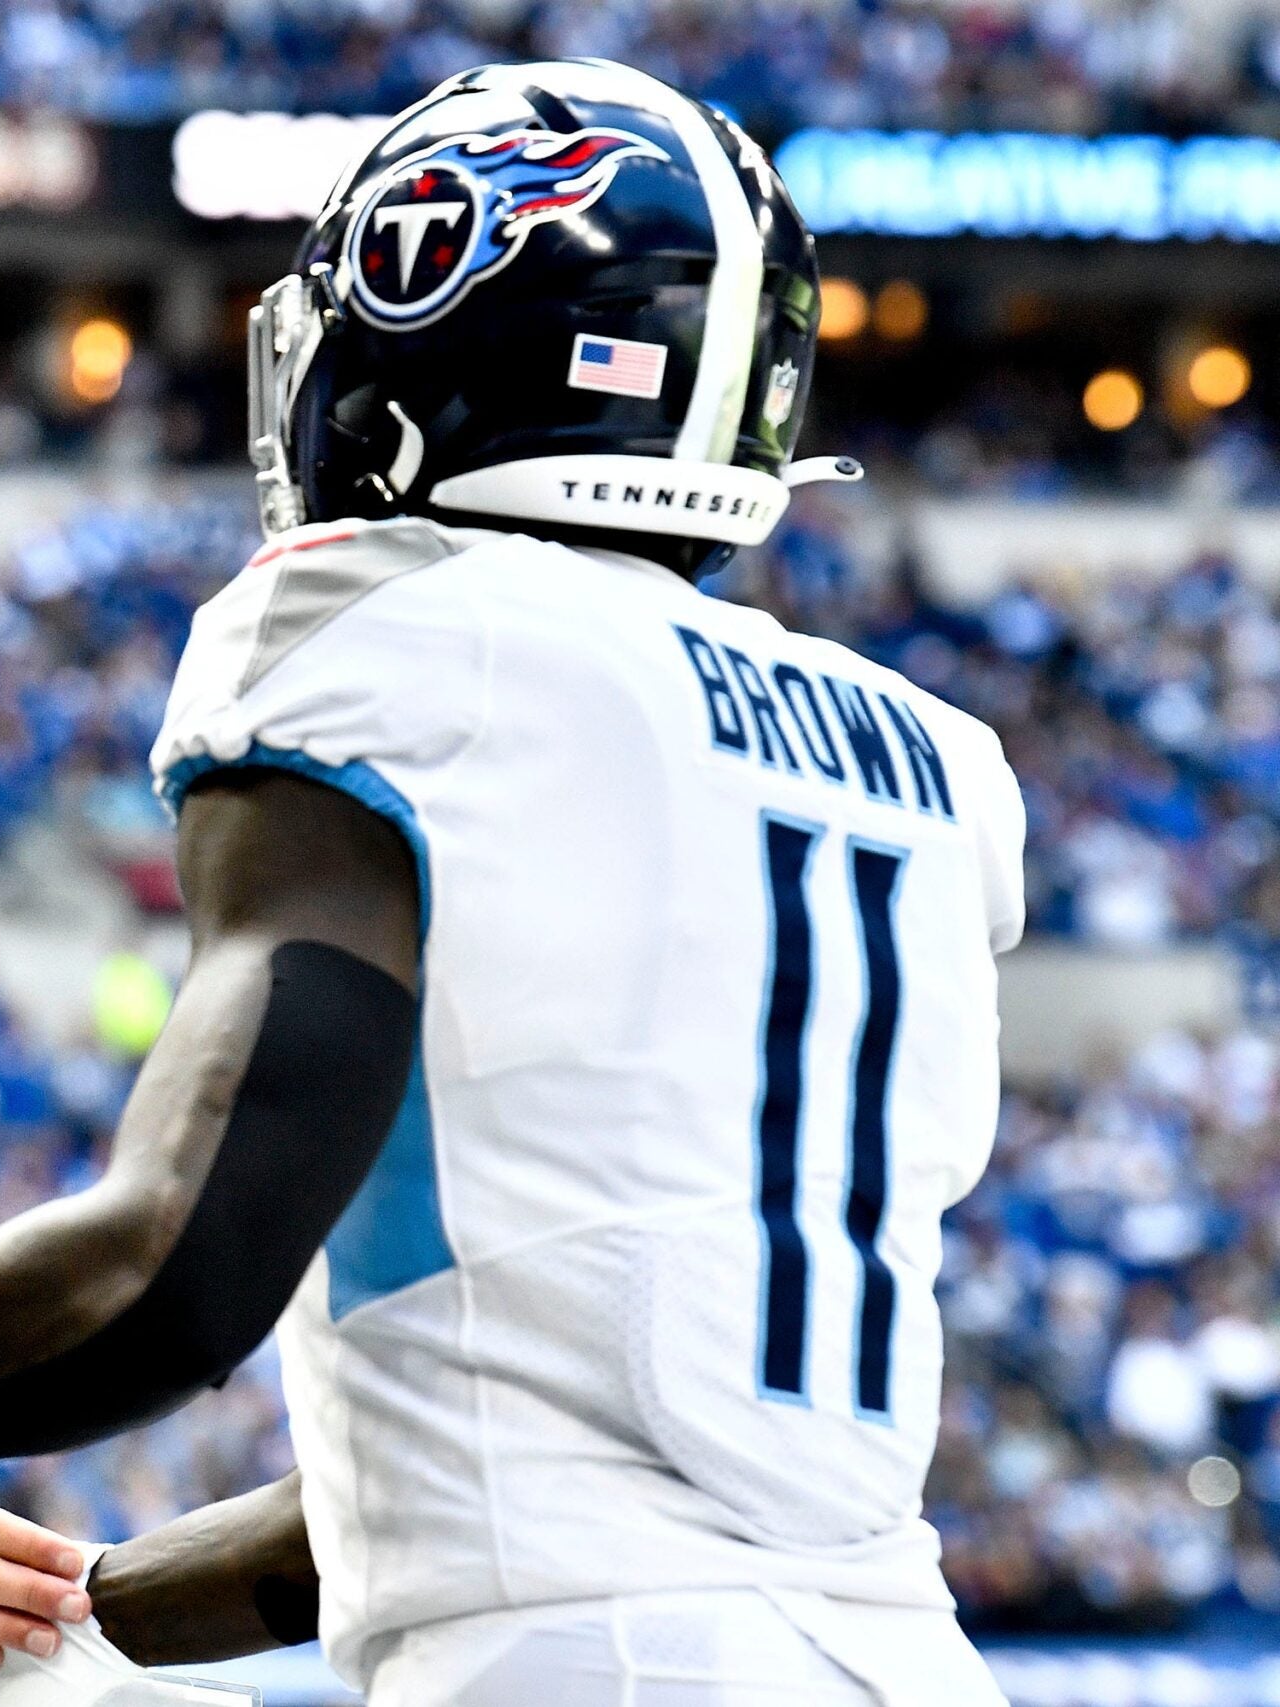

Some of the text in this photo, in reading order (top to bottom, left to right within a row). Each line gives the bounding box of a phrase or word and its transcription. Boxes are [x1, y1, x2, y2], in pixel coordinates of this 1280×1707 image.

[374, 200, 468, 294] T
[669, 620, 958, 824] BROWN
[751, 807, 912, 1427] 11
